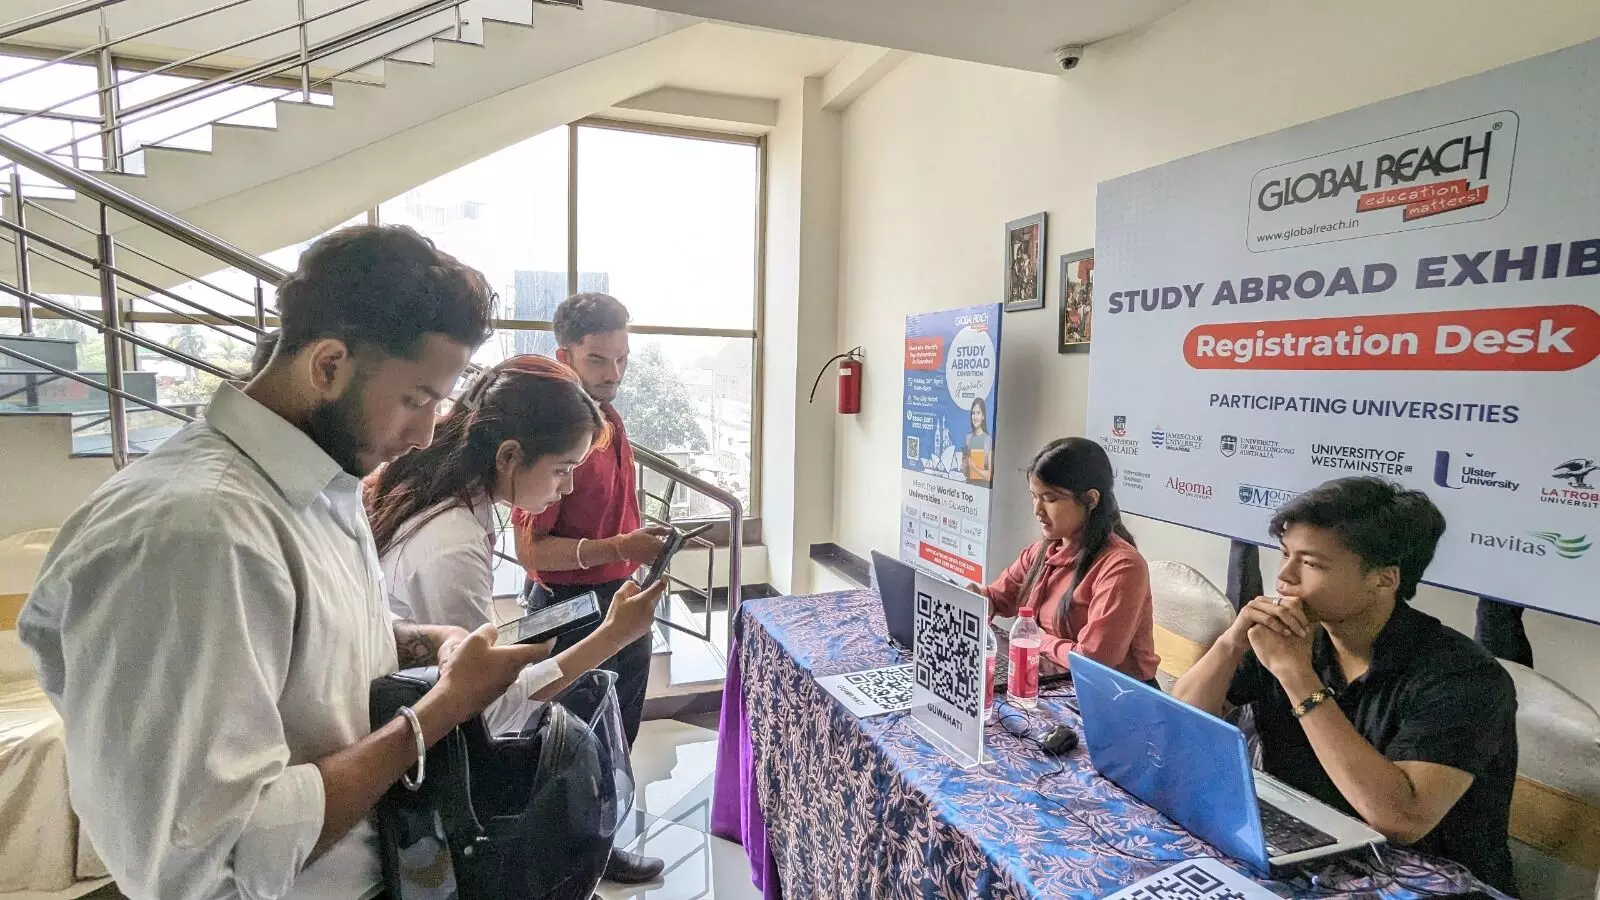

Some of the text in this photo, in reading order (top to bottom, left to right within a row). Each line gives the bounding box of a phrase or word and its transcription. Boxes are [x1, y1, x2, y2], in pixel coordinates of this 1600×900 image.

[1257, 131, 1492, 212] GLOBAL REACH
[1364, 185, 1459, 207] education
[1409, 189, 1480, 216] matters!
[1256, 218, 1359, 243] www.globalreach.in
[1108, 239, 1600, 314] STUDY ABROAD EXHIB
[1197, 319, 1577, 363] Registration Desk
[956, 345, 986, 357] STUDY
[951, 358, 990, 370] ABROAD
[1209, 393, 1520, 424] PARTICIPATING UNIVERSITIES
[1240, 437, 1280, 447] UNIVERSITY
[1249, 445, 1295, 455] WOLLONGONG
[1239, 451, 1275, 459] AUSTRALIA
[1311, 443, 1405, 462] UNIVERSITY OF
[1311, 455, 1404, 476] WESTMINSTER
[1462, 466, 1496, 479] Ulster
[1165, 476, 1213, 496] Algoma
[1461, 475, 1520, 491] University
[1541, 487, 1558, 498] LA
[908, 488, 940, 505] Universities
[936, 485, 960, 498] World's
[962, 491, 974, 503] Top
[1470, 532, 1547, 556] navitas
[927, 703, 963, 732] GUWAHATI
